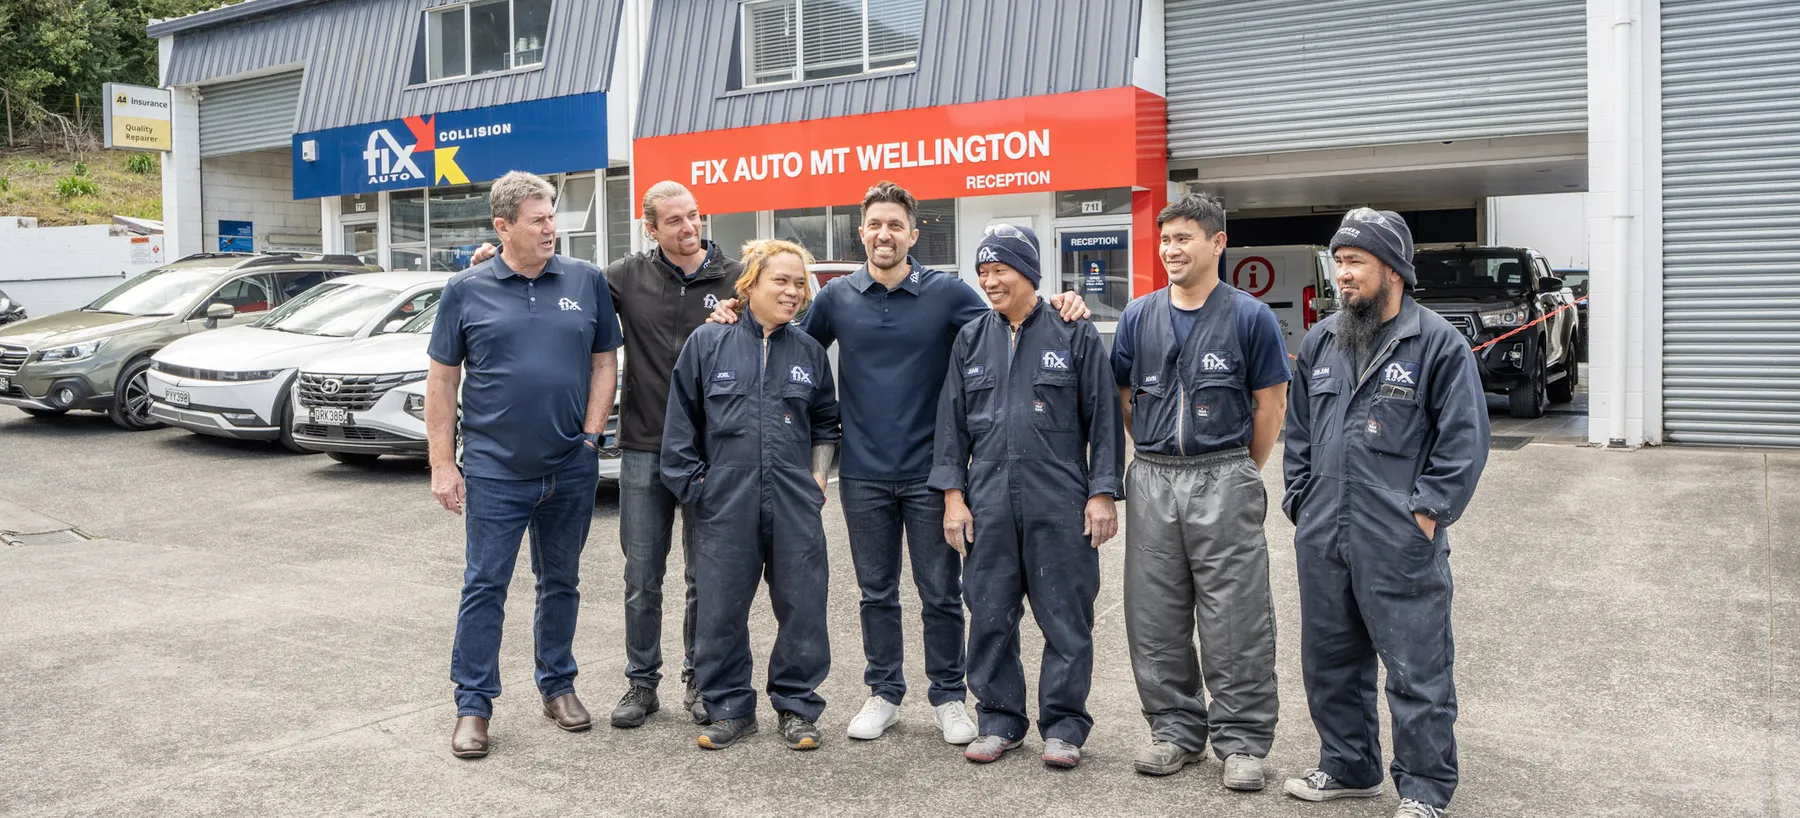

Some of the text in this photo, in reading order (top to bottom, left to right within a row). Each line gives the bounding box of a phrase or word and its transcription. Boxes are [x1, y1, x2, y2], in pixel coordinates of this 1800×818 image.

[116, 95, 168, 108] AA Insurance
[125, 124, 153, 134] Quality
[439, 123, 511, 142] COLLISION
[125, 134, 158, 142] Repairer
[691, 129, 1050, 185] FIX AUTO MT WELLINGTON
[368, 173, 410, 184] AUTO
[966, 170, 1051, 189] RECEPTION
[1071, 236, 1118, 246] RECEPTION
